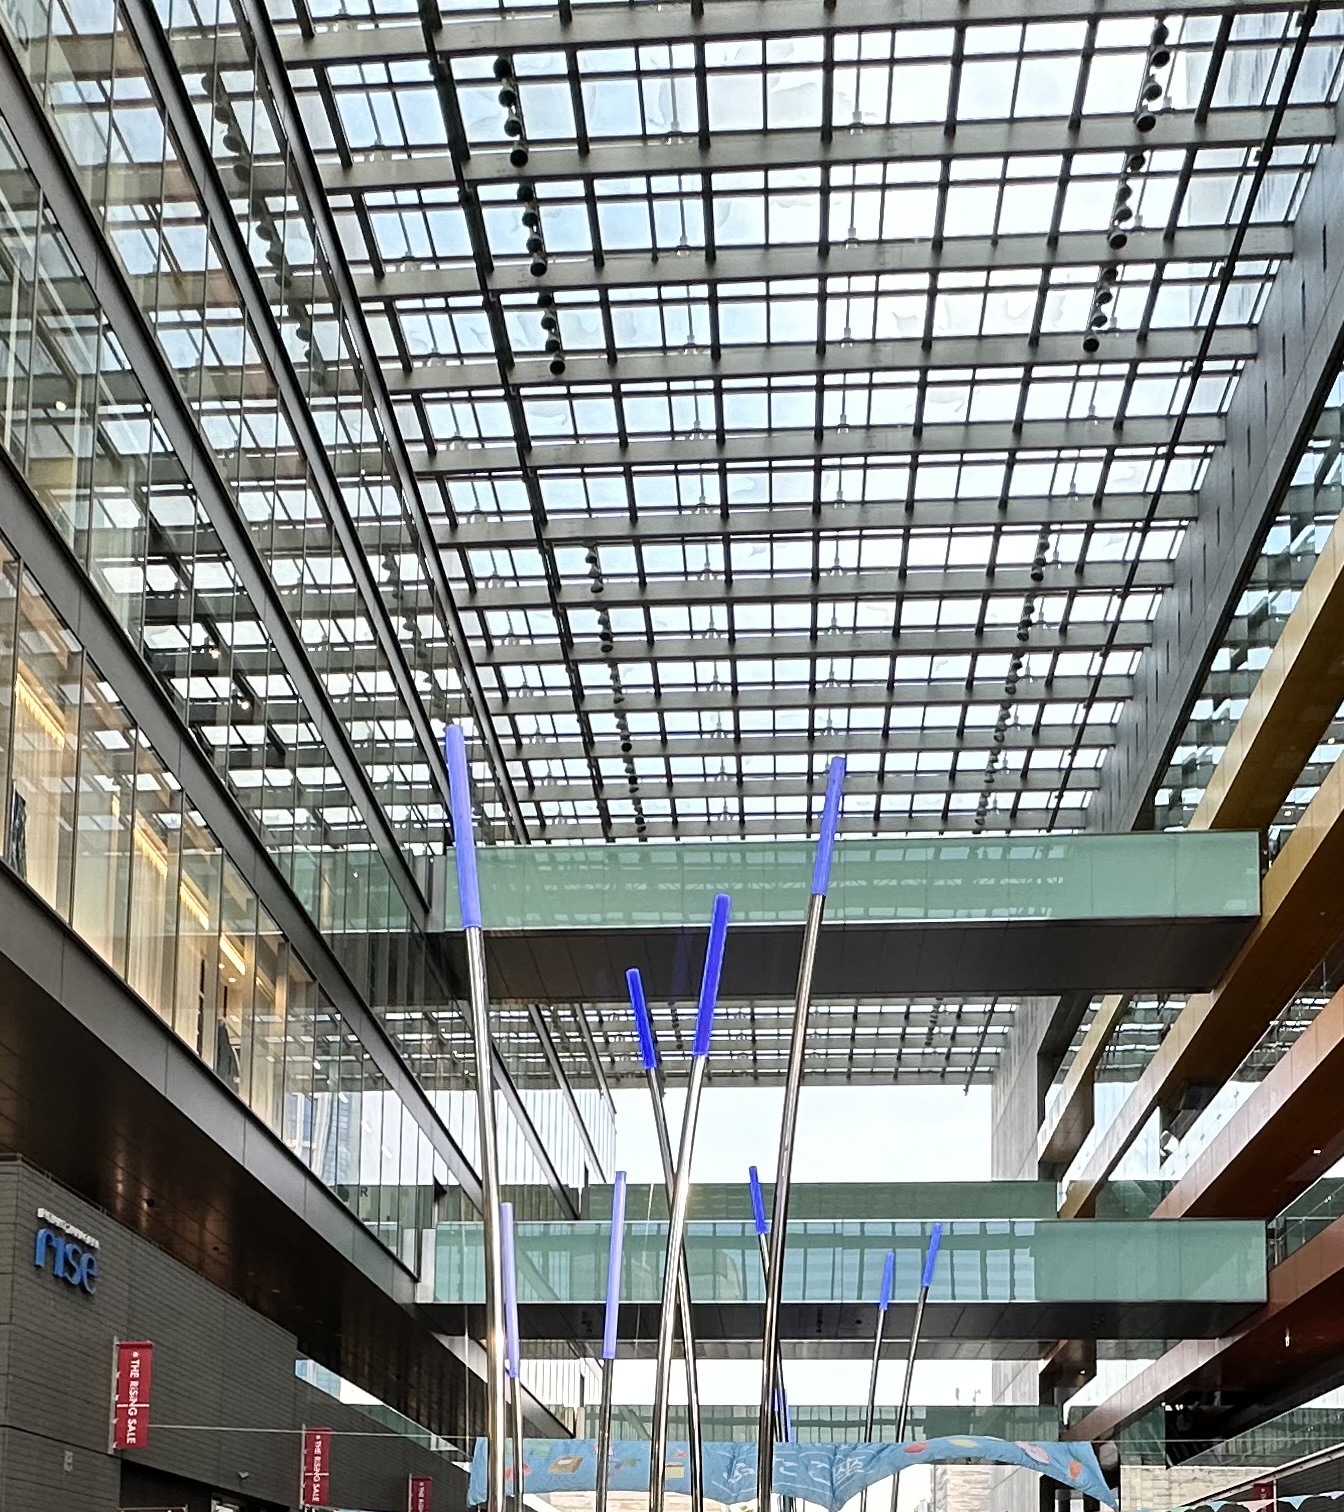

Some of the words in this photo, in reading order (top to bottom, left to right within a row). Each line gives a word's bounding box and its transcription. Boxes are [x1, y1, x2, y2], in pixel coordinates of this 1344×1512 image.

[35, 1228, 100, 1294] rise
[129, 1359, 141, 1378] THE
[126, 1418, 137, 1444] SALE
